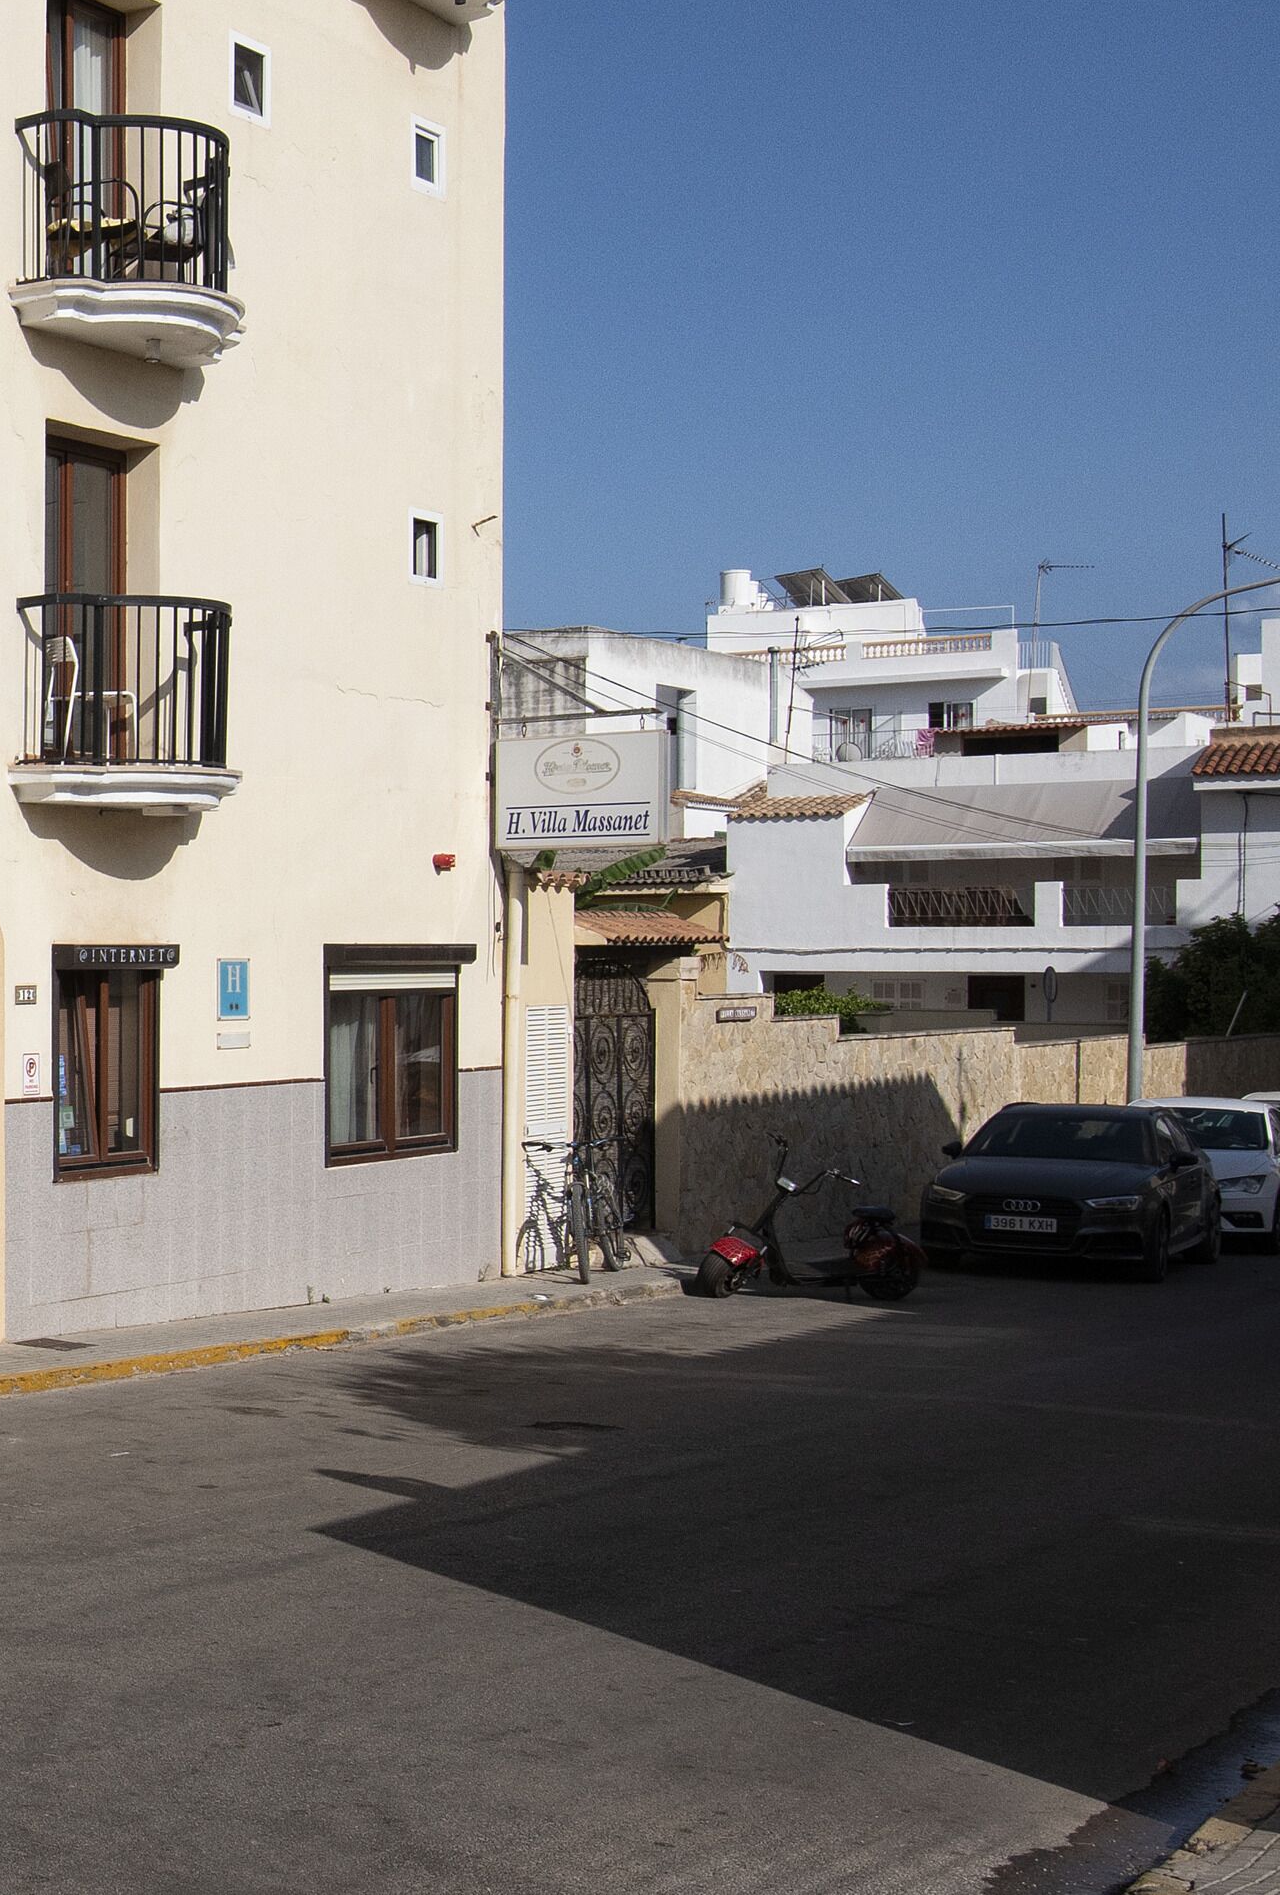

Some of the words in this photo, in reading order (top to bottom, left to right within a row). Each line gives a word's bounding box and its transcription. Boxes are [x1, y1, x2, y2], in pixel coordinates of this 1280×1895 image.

[506, 812, 526, 835] H.
[530, 810, 567, 834] Villa
[572, 809, 651, 833] Massanet
[226, 965, 241, 993] H
[22, 990, 32, 1000] 12
[992, 1217, 1025, 1229] 3961
[1028, 1219, 1053, 1231] KXH
